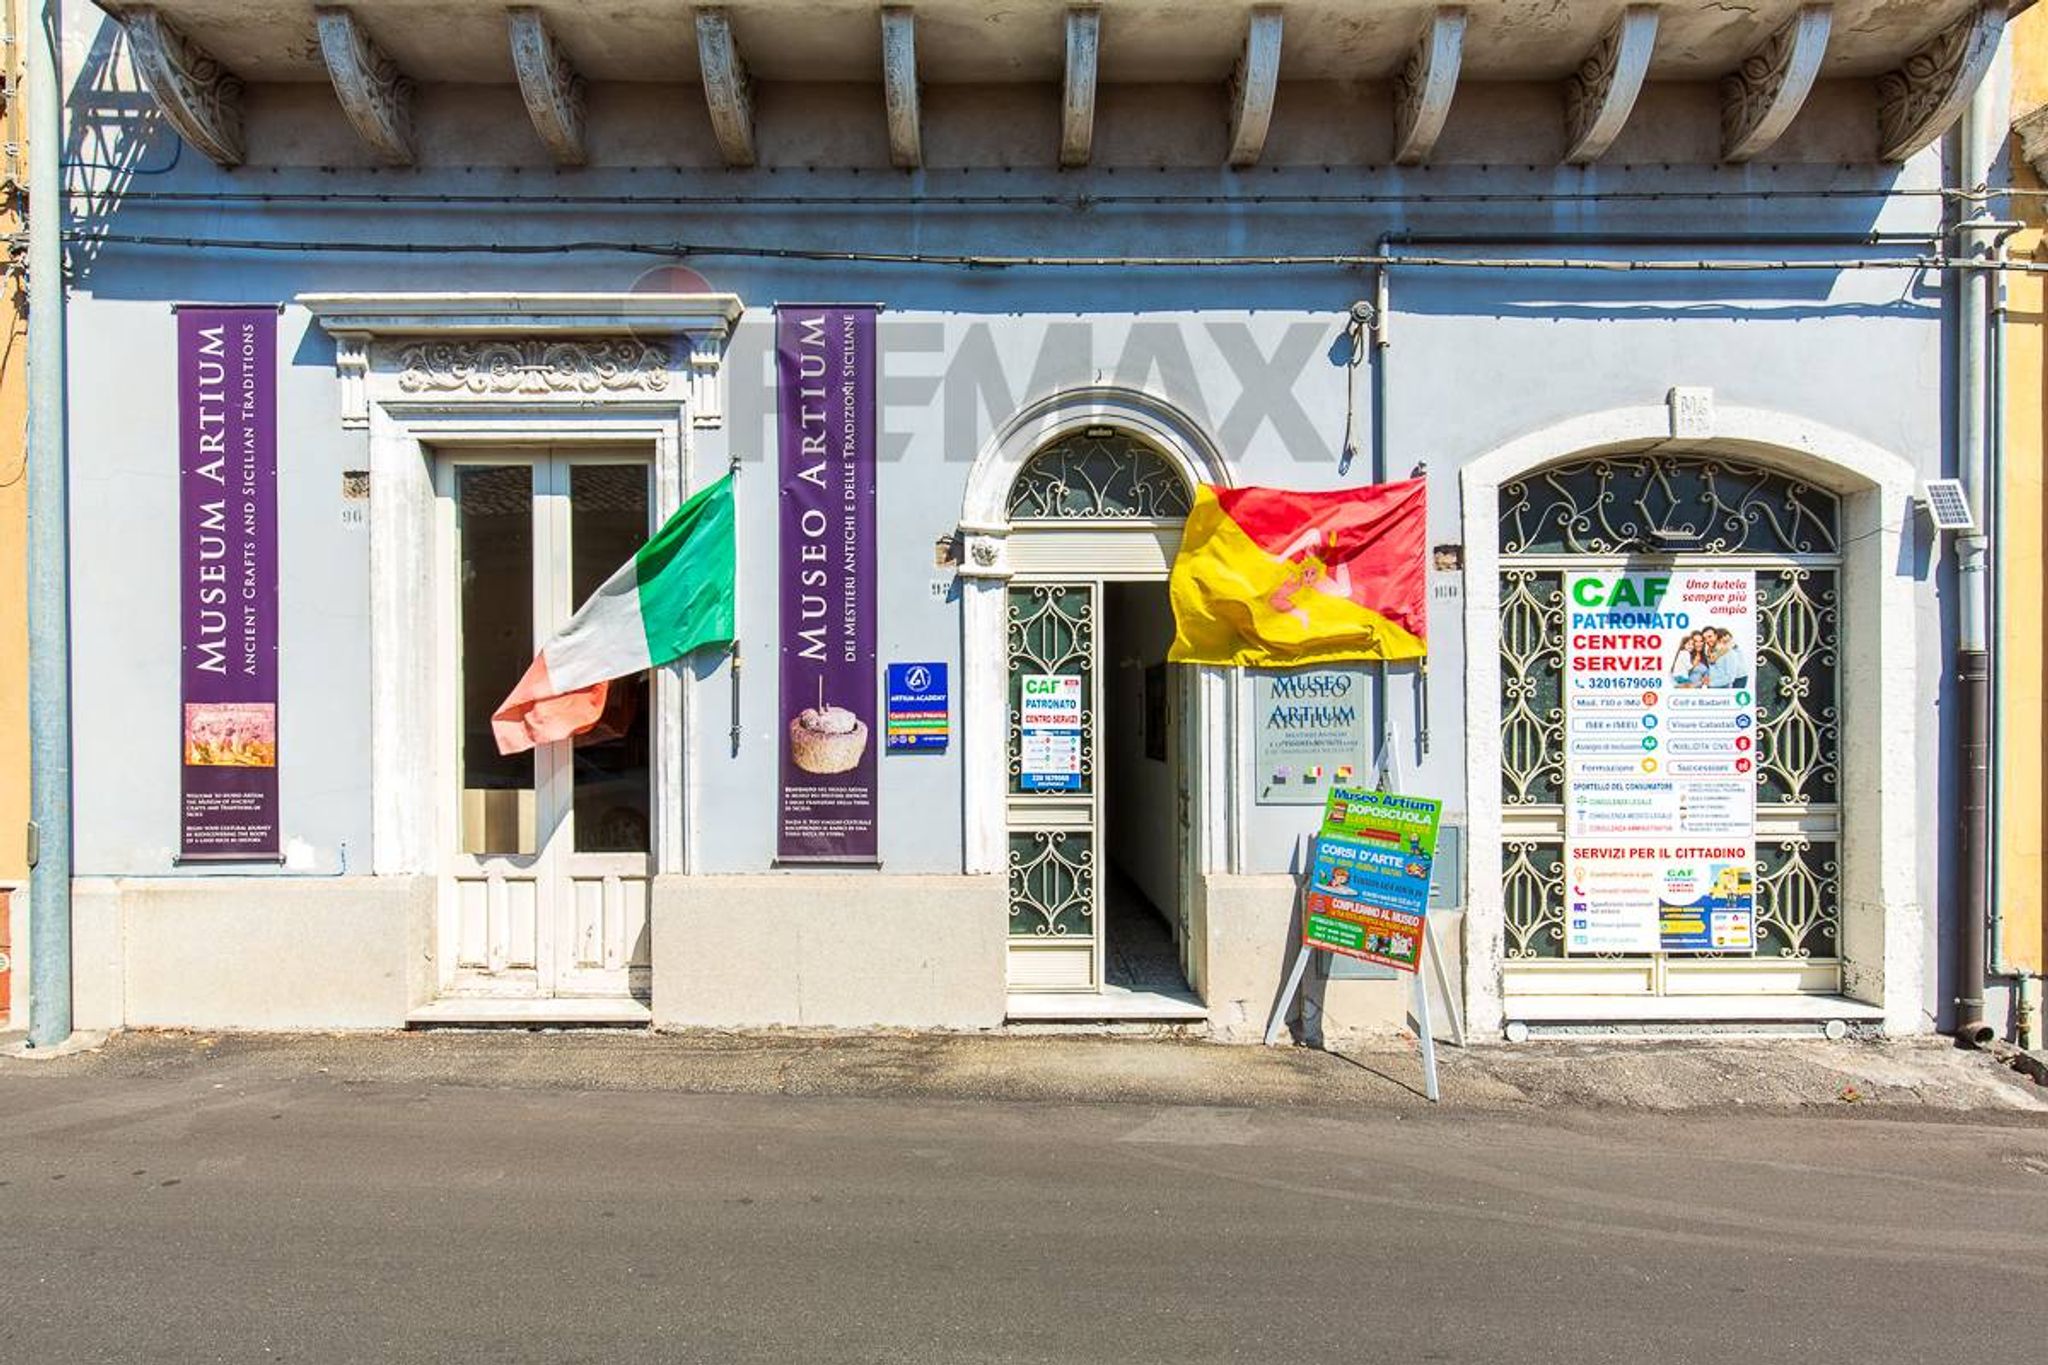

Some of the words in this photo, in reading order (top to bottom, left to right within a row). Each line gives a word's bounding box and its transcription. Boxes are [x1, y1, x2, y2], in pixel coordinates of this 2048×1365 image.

[841, 314, 856, 377] SICILIANE
[241, 324, 256, 421] TRADITIONS
[194, 325, 228, 487] ARTIUM
[797, 314, 827, 489] ARTIUM
[842, 382, 857, 459] TRADIZIONI
[242, 427, 257, 496] SICILIAN
[842, 463, 857, 502] DELLE
[242, 502, 257, 536] AND
[842, 504, 857, 512] E
[842, 515, 857, 573] ANTICHI
[242, 542, 257, 599] CRAFTS
[195, 499, 228, 675] MUSEUM
[797, 509, 829, 662] MUSEO
[1572, 577, 1671, 607] CAF
[1712, 579, 1747, 590] tutela
[842, 575, 857, 637] MESTIERI
[1682, 593, 1724, 604] sempre
[1727, 591, 1747, 604] più
[1573, 613, 1690, 630] PATRONATO
[1710, 605, 1747, 616] ampio
[242, 606, 257, 675] ANCIENT
[842, 640, 857, 663] DEI
[1573, 635, 1663, 650] CENTRO
[1573, 656, 1663, 671] SERVIZI
[1026, 680, 1060, 694] CAF
[1274, 674, 1352, 692] MUSEO
[1588, 677, 1663, 690] 3201679069
[916, 694, 947, 702] ACADEMY
[1026, 699, 1076, 709] PATRONATO
[1026, 715, 1051, 724] CENTRO
[1053, 715, 1078, 724] SERVIZI
[1272, 704, 1356, 722] ARTIUM
[1610, 783, 1623, 792] DEL
[1334, 788, 1379, 803] Museo
[1382, 795, 1435, 812] Artium
[1347, 803, 1432, 825] DOPOSCUOLA
[1321, 843, 1357, 860] CORSI
[1360, 850, 1405, 868] D'ARTE
[1573, 848, 1626, 859] SERVIZI
[1630, 848, 1655, 859] PER
[1659, 848, 1671, 859] IL
[1675, 848, 1746, 859] CITTADINO
[1332, 898, 1380, 916] COMPLEANNO
[1380, 907, 1389, 919] AL
[1390, 910, 1420, 926] MUSEO
